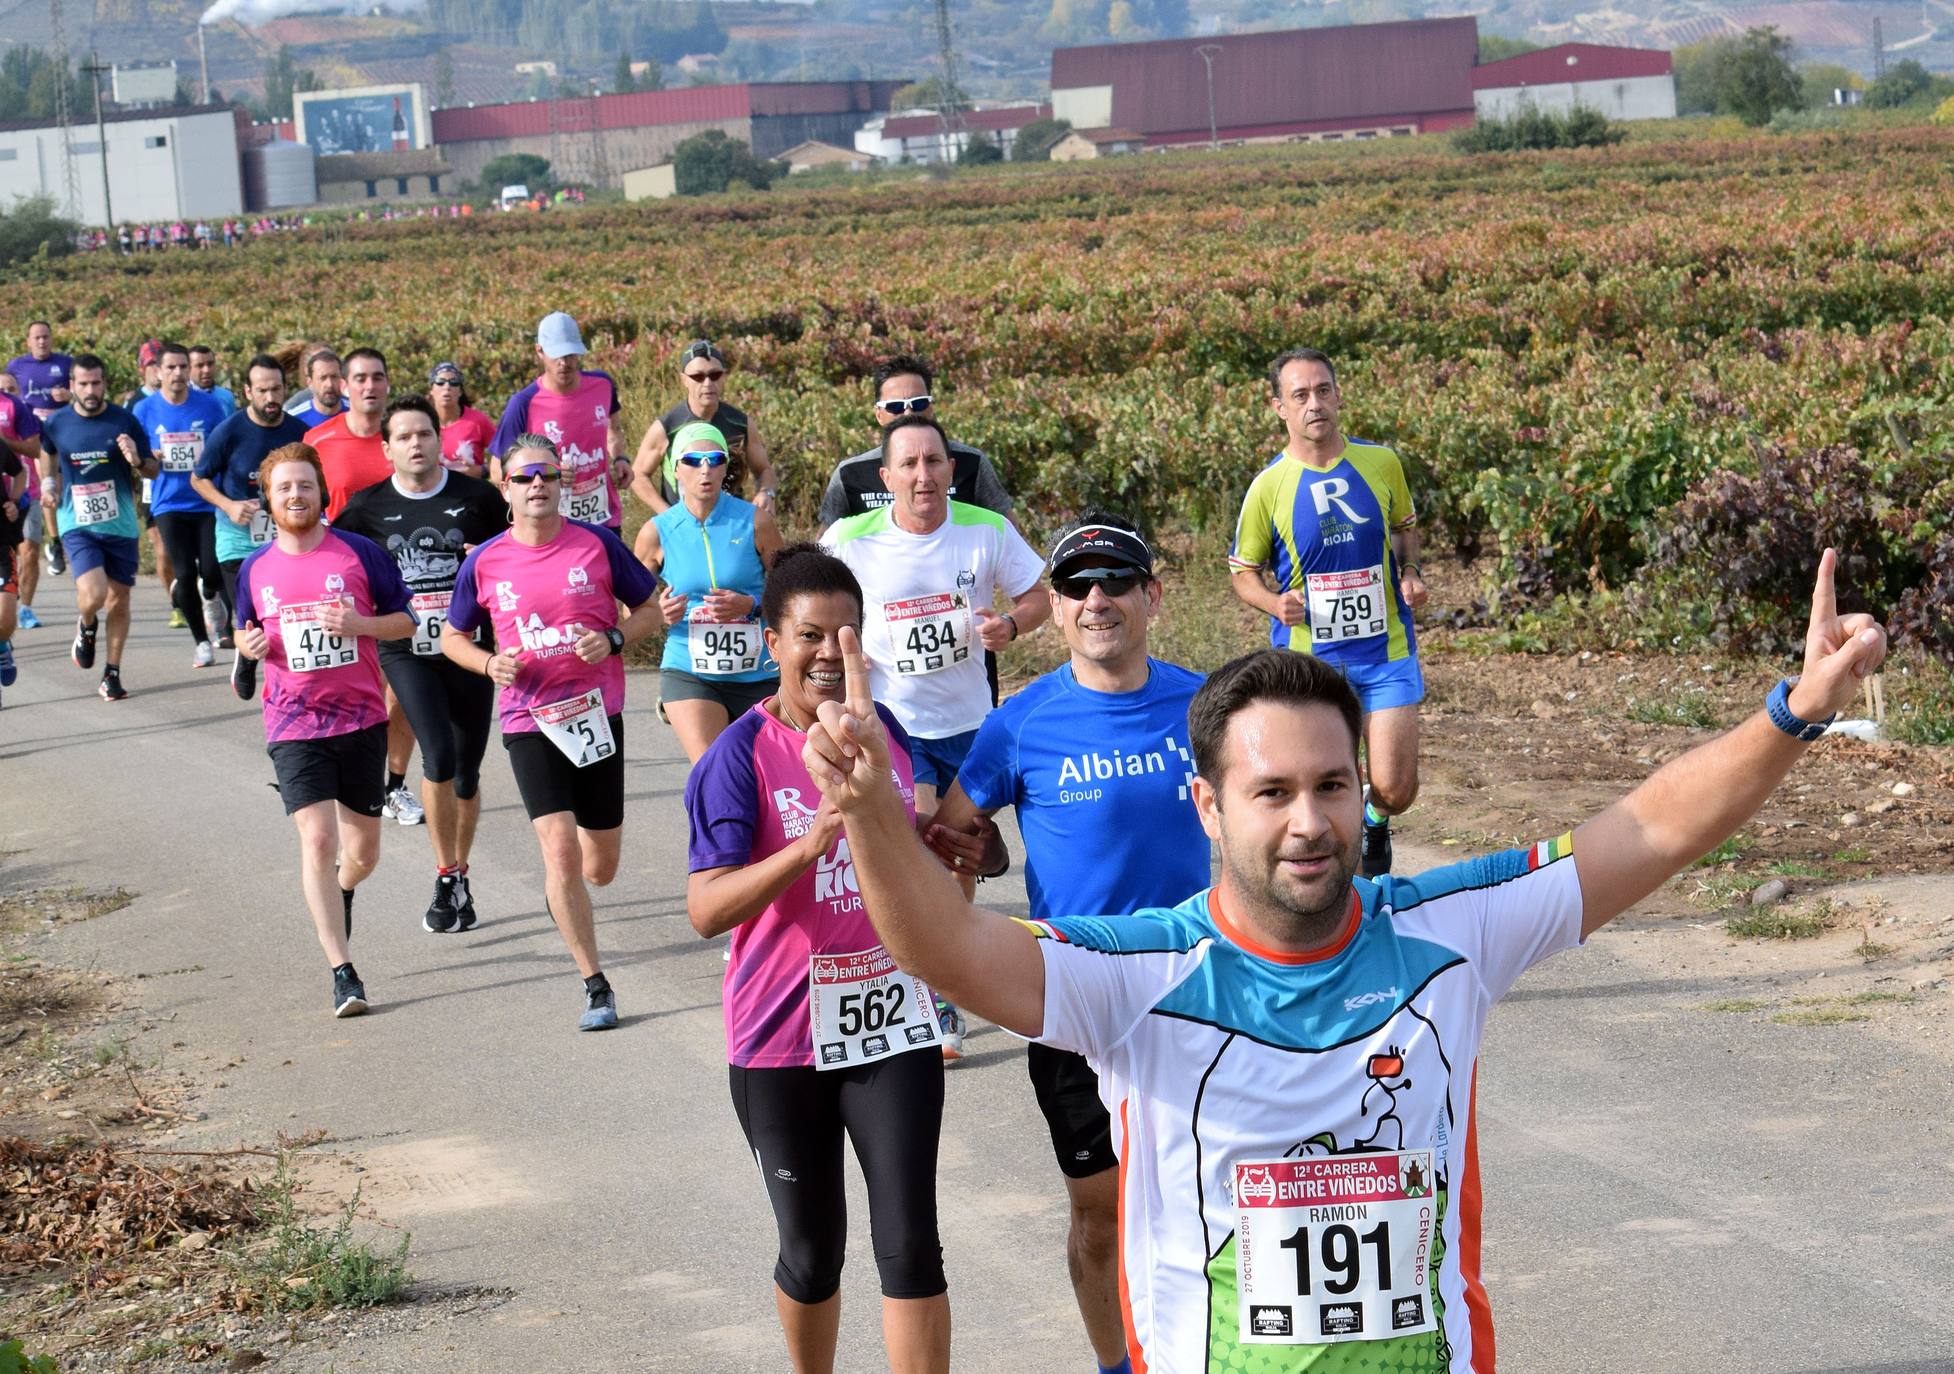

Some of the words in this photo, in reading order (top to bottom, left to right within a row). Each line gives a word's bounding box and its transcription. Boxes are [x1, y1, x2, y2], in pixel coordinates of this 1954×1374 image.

[171, 447, 195, 461] 654
[83, 497, 109, 514] 383
[570, 495, 599, 517] 552
[1310, 477, 1370, 524] R
[1323, 532, 1355, 546] RIOJA
[901, 605, 923, 617] ENTRE
[922, 600, 951, 613] VIÑEDOS
[1326, 594, 1372, 624] 759
[515, 613, 545, 633] LA
[914, 615, 941, 624] MANUEL
[704, 631, 747, 656] 945
[907, 620, 957, 655] 434
[1058, 749, 1165, 786] Albian
[773, 787, 818, 815] R
[1060, 788, 1102, 803] Group
[781, 810, 798, 821] CLUB
[840, 964, 869, 979] ENTRE
[860, 976, 889, 990] YTALIA
[838, 983, 906, 1036] 562
[1314, 1161, 1378, 1176] CARRERA
[1278, 1179, 1326, 1200] ENTRE
[1328, 1173, 1397, 1197] VIÑEDOS
[1310, 1203, 1368, 1223] RAMÓN
[1241, 1215, 1250, 1238] 2019
[1415, 1206, 1430, 1286] CENICERO
[1243, 1239, 1252, 1280] OCTUBRE
[1280, 1221, 1392, 1296] 191
[1245, 1282, 1253, 1293] 27
